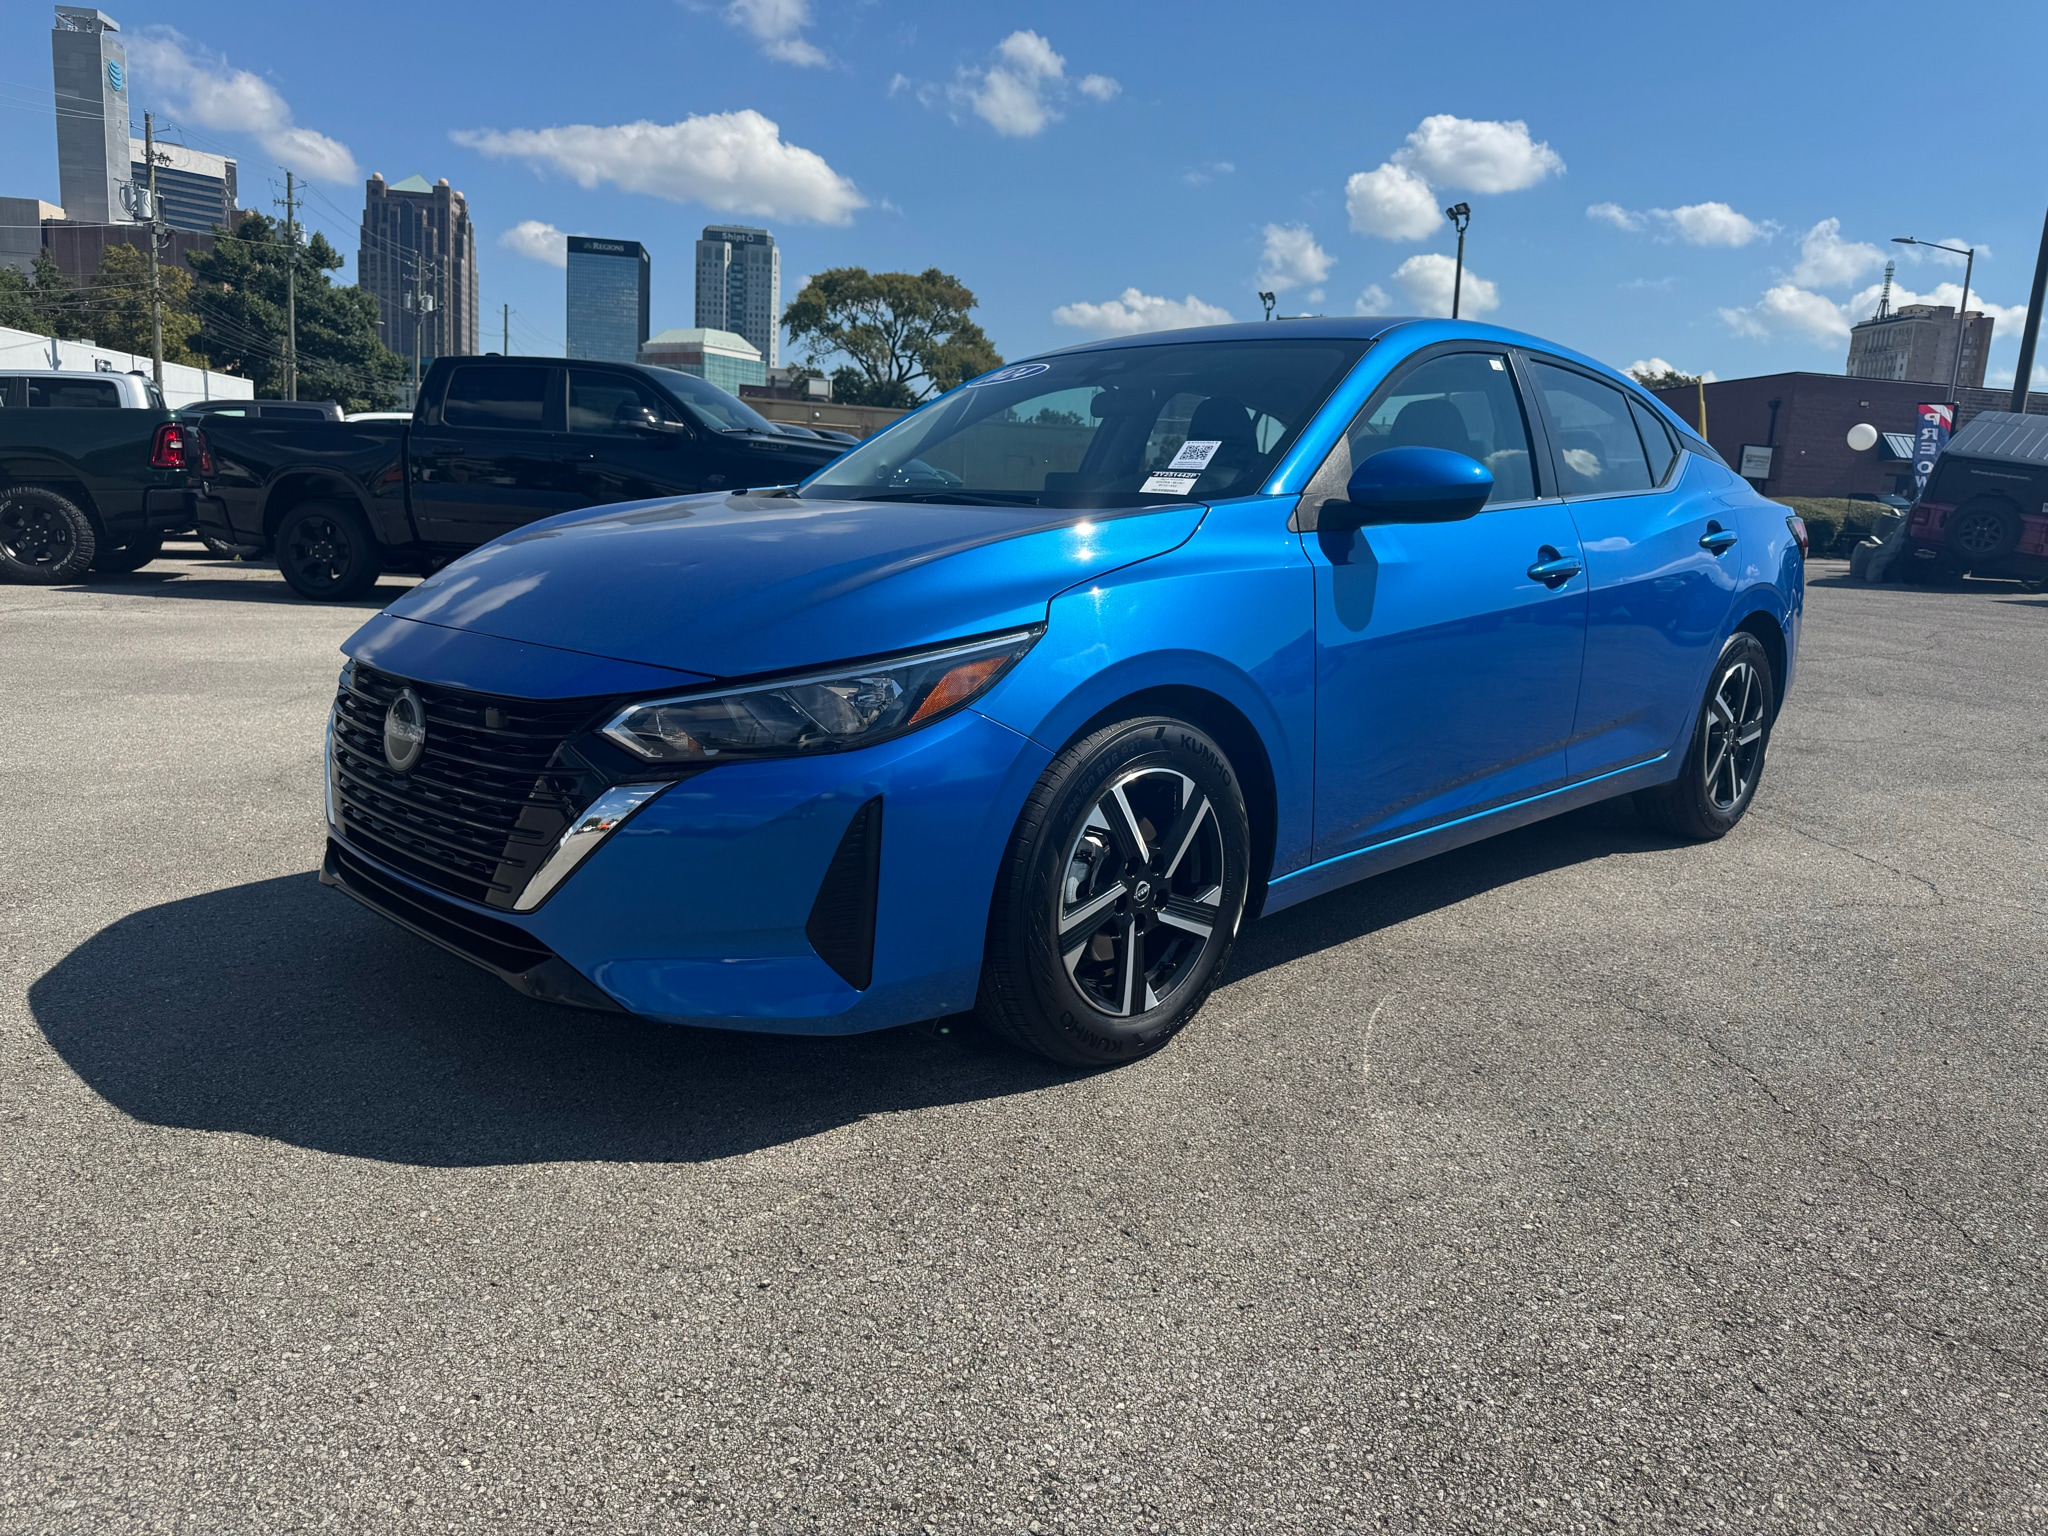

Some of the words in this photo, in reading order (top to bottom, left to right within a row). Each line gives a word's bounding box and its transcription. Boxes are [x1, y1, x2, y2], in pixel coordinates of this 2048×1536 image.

[722, 232, 746, 242] Shipt
[592, 242, 625, 252] REGIONS
[1180, 733, 1232, 788] KUMHO
